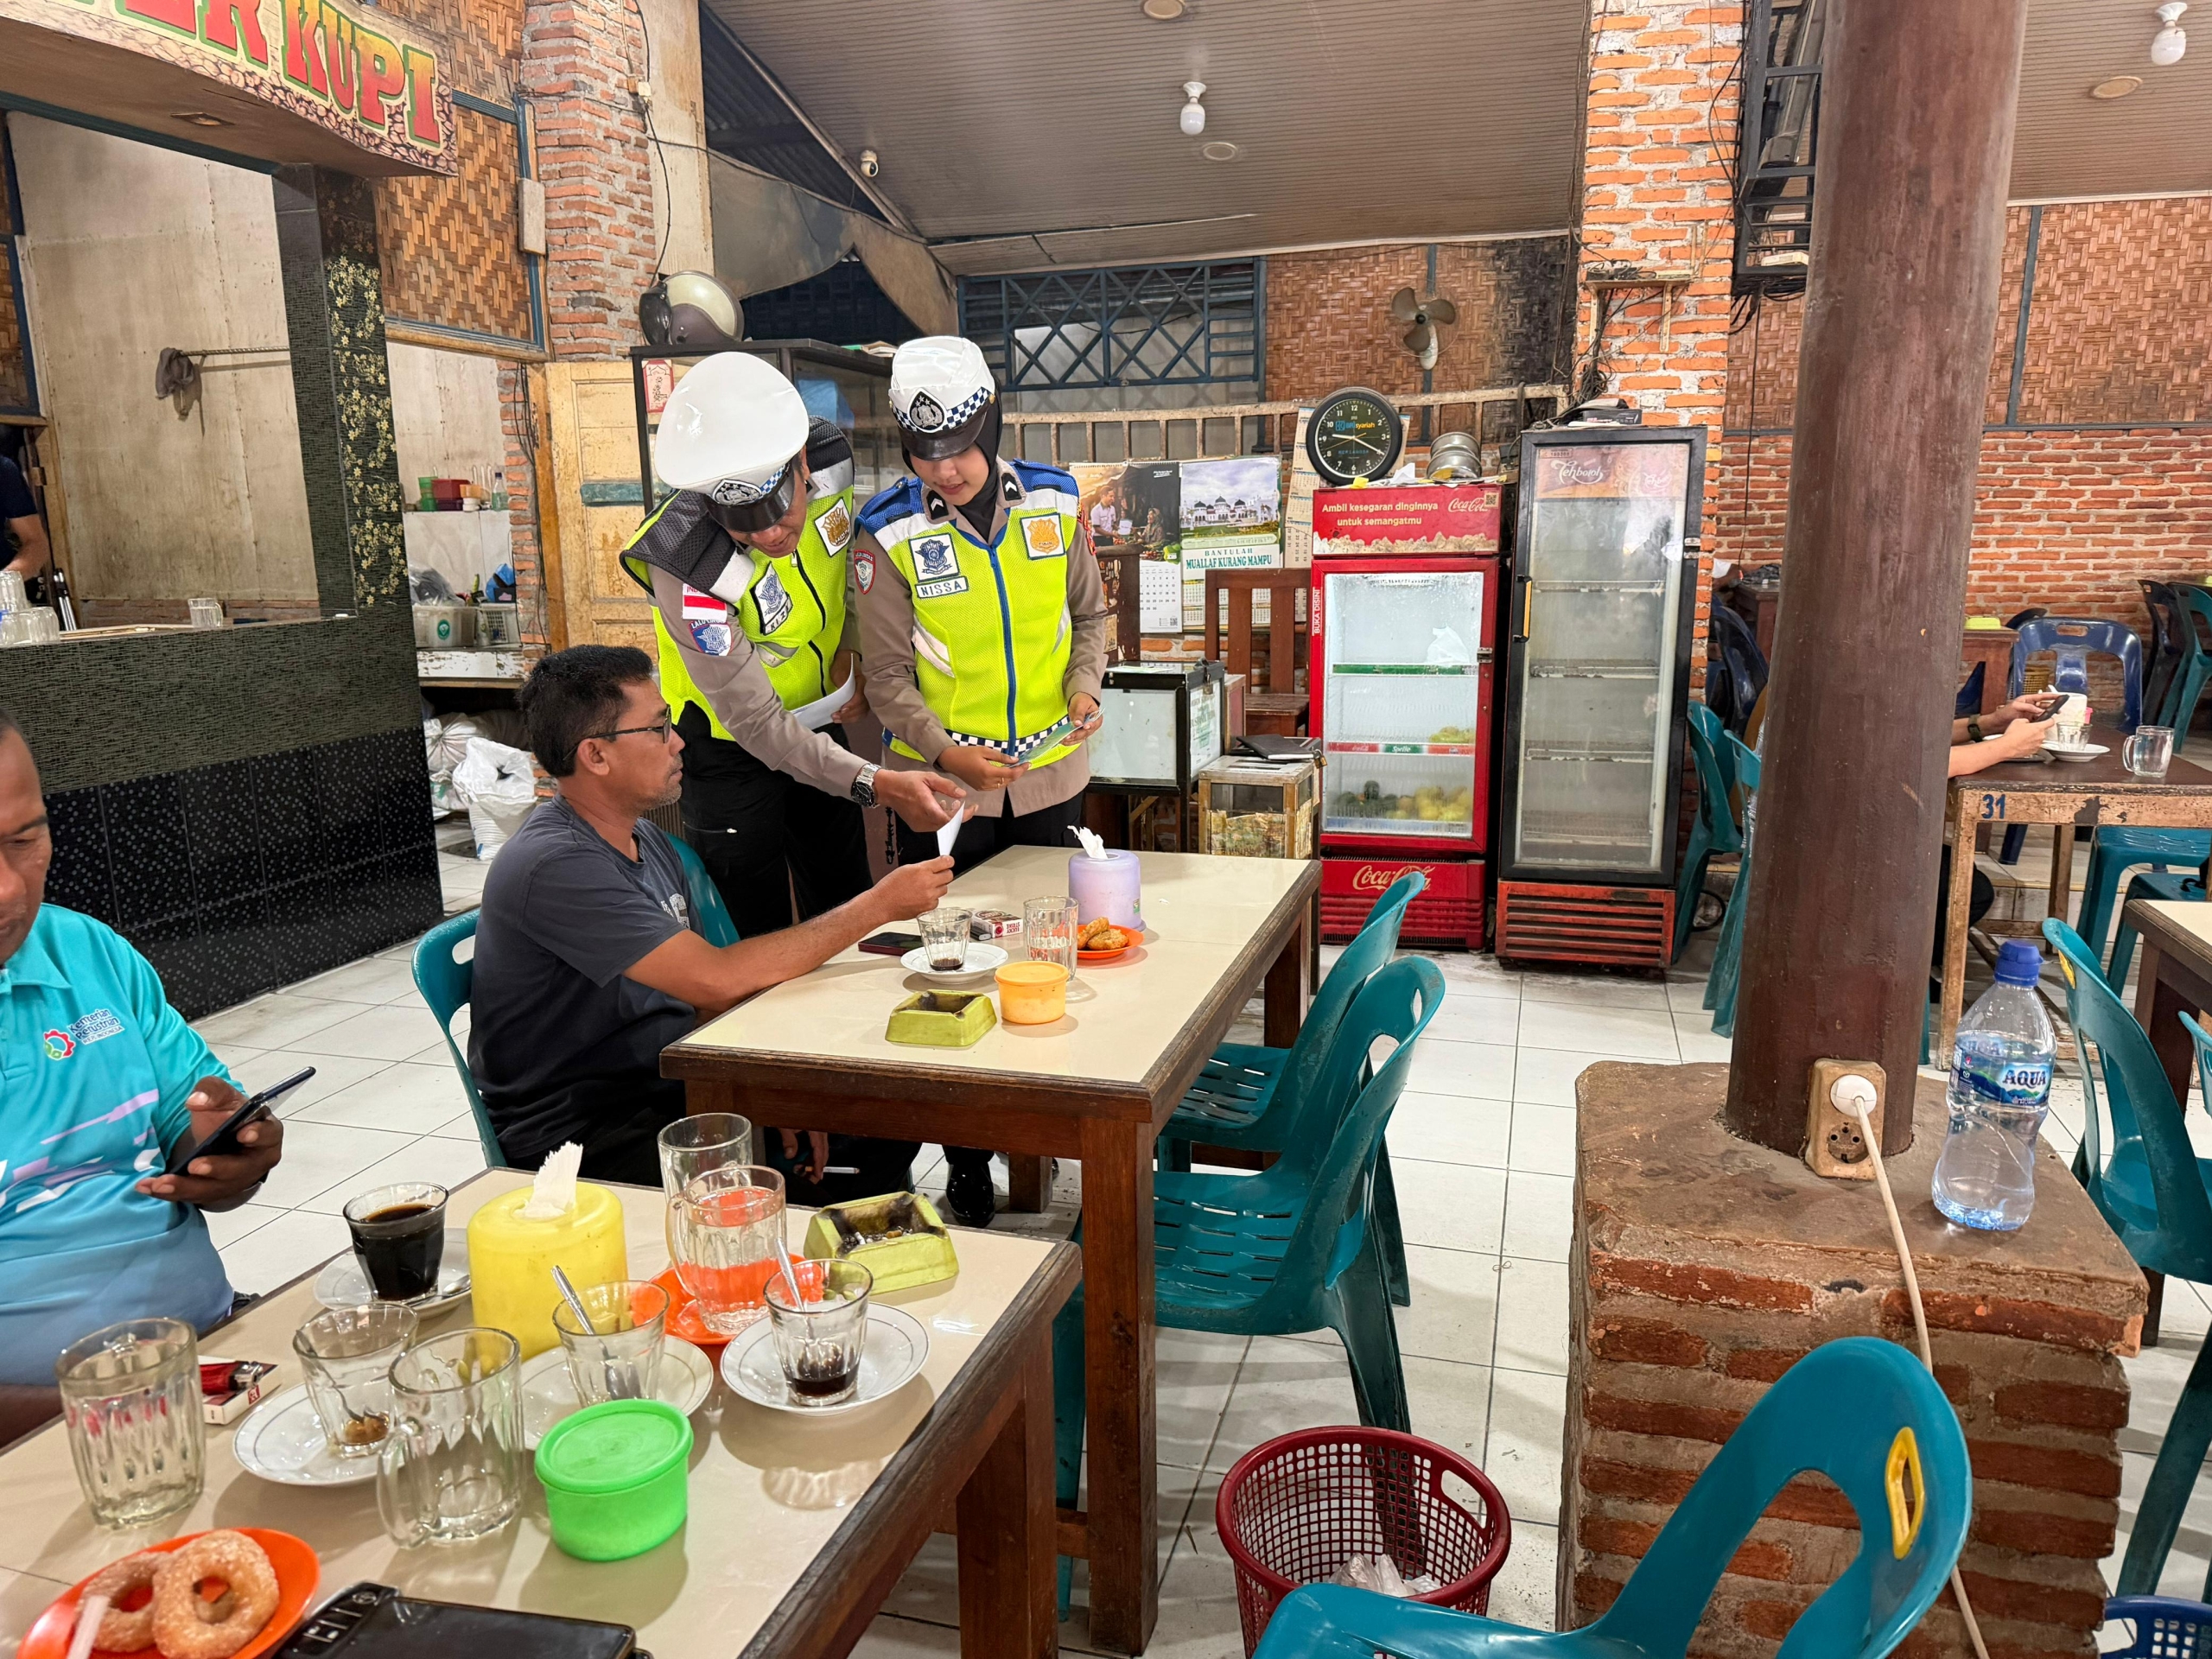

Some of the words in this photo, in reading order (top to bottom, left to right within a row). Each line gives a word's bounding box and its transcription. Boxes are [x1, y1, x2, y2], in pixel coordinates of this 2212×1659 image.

[281, 0, 441, 148] KUPI
[1322, 502, 1347, 512] Ambil
[1349, 502, 1393, 513] kesegaran
[1395, 501, 1439, 512] dinginnya
[1337, 517, 1363, 526] untuk
[1364, 517, 1422, 526] semangatmu
[1205, 548, 1253, 556] BANTULAH
[1186, 558, 1217, 569] MUALLAF
[1218, 556, 1246, 568] KURANG
[1248, 555, 1272, 566] MAMPU
[920, 580, 962, 596] NISSA
[1981, 794, 2005, 819] 31
[2003, 1070, 2046, 1089] AQUA
